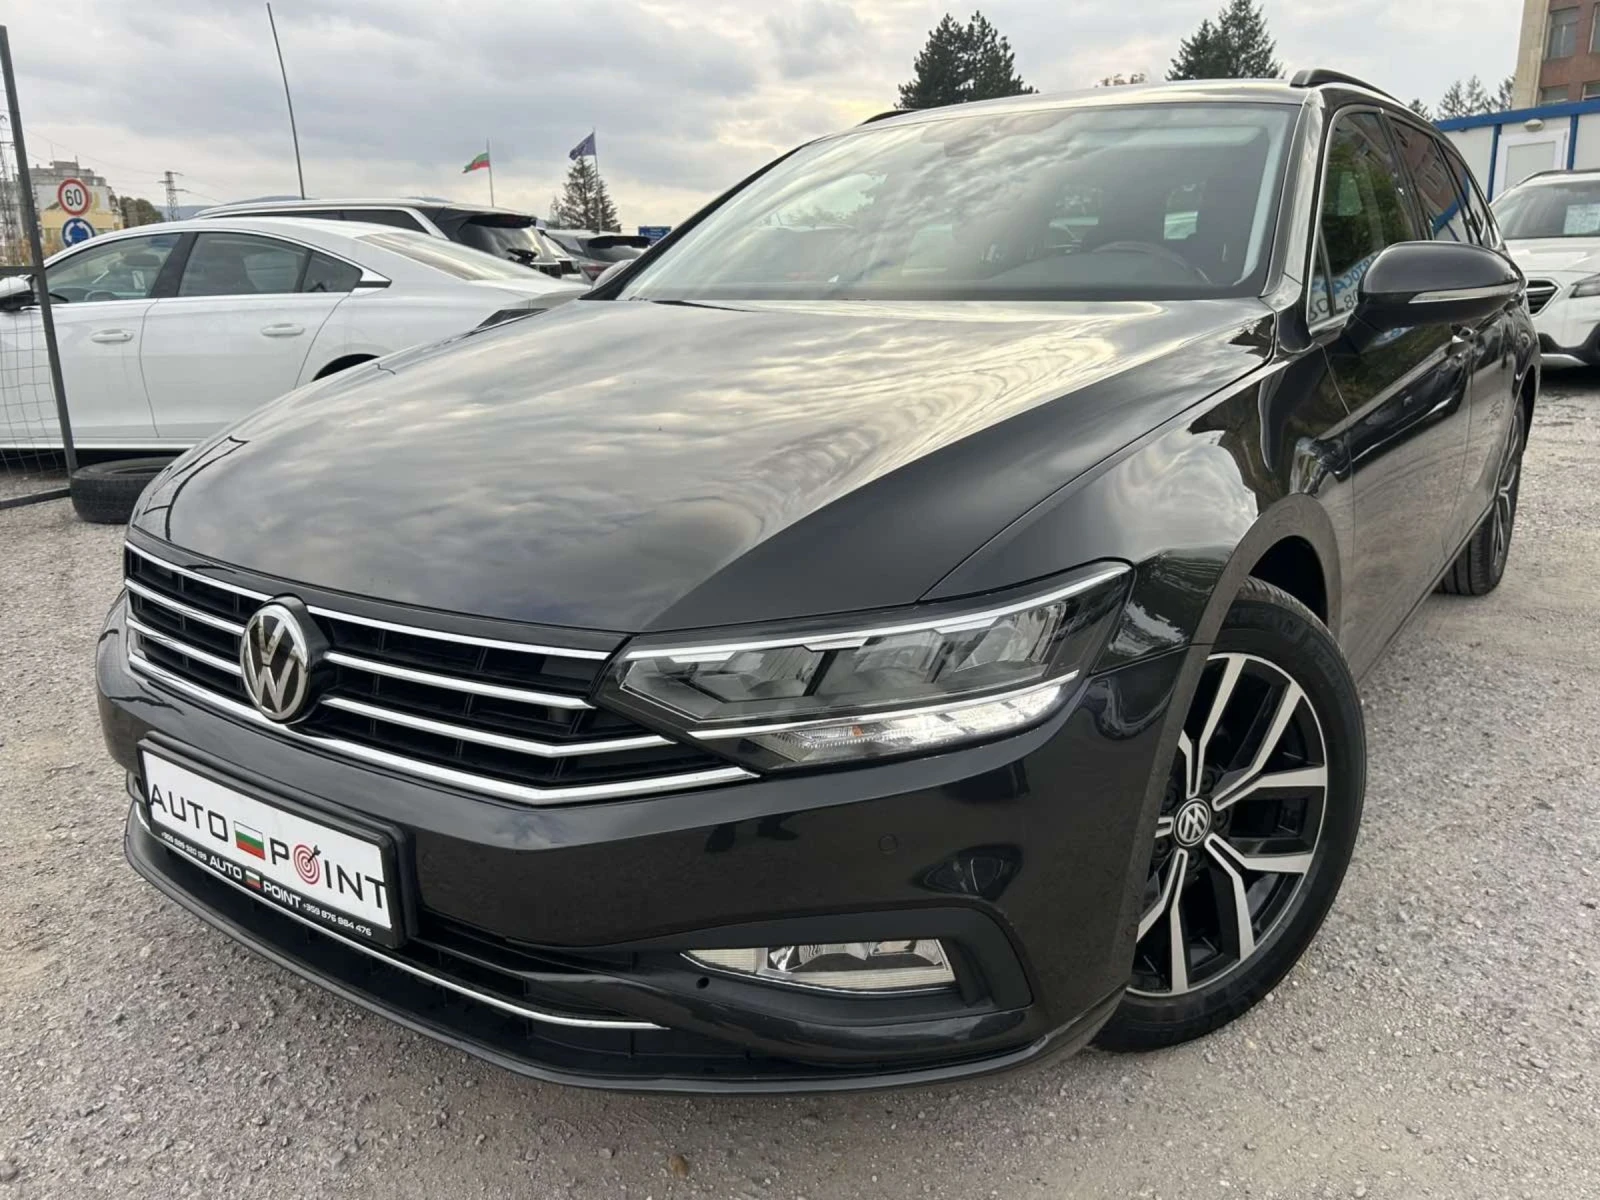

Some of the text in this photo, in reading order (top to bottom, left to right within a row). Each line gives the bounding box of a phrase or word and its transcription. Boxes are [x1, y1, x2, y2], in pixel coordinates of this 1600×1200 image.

[65, 188, 83, 206] 60
[241, 606, 307, 719] VW
[150, 783, 229, 843] AUTO
[209, 855, 243, 880] AUTO
[263, 880, 302, 908] POINT
[355, 923, 373, 937] 476
